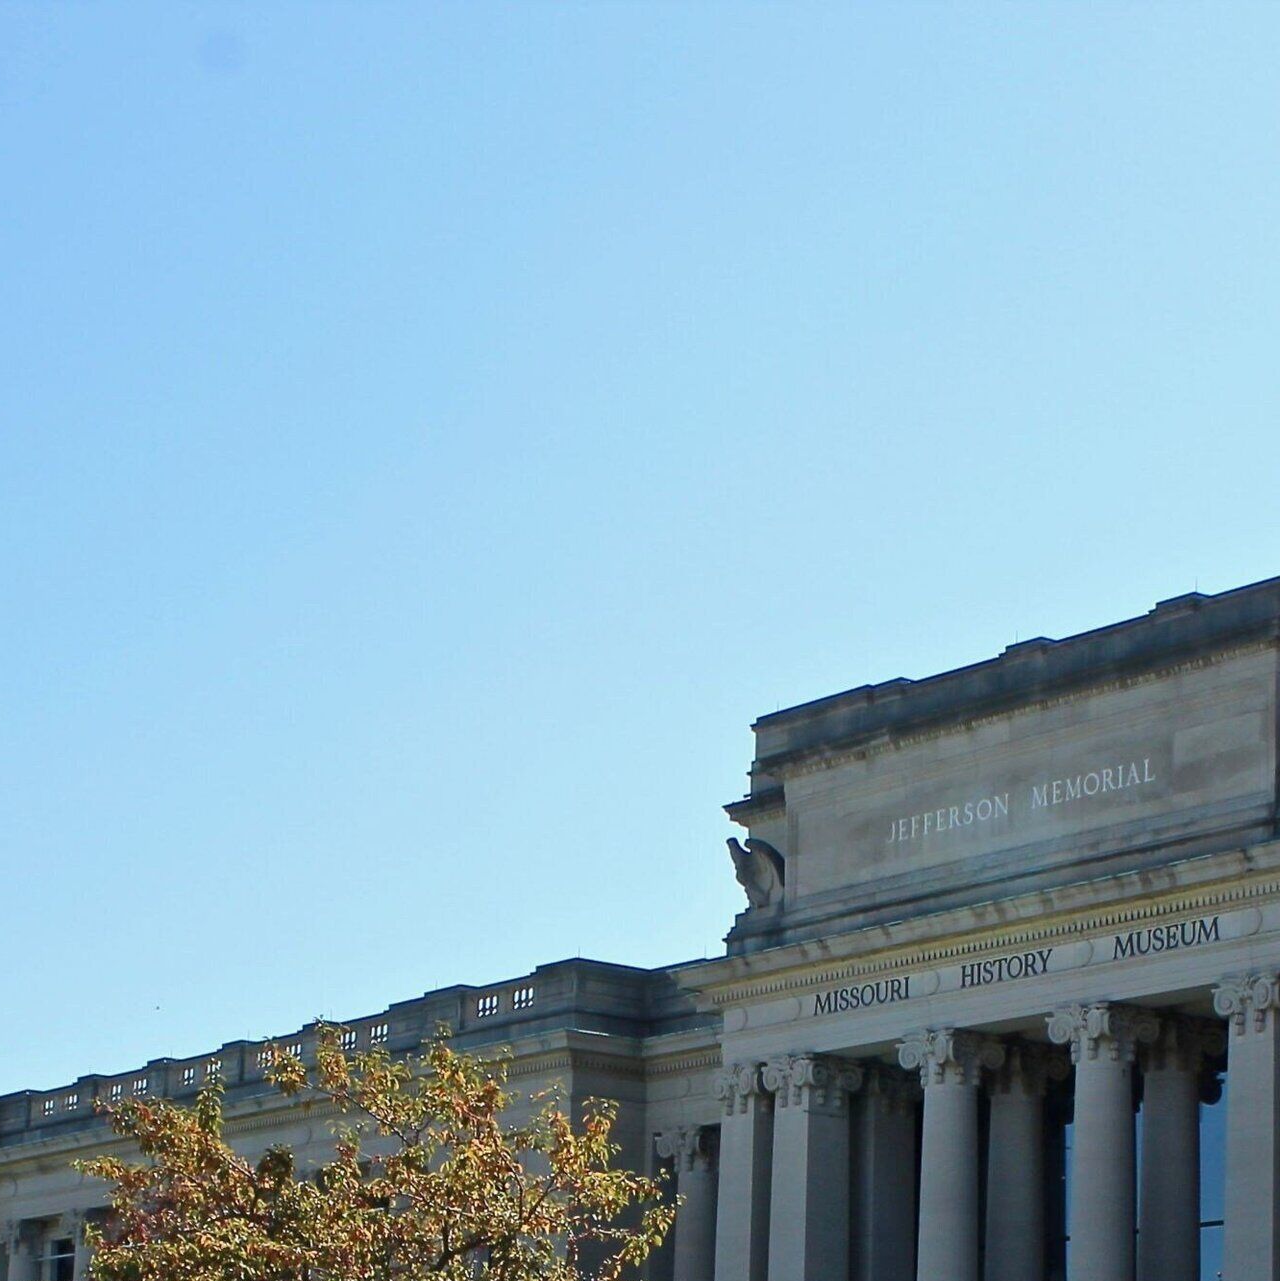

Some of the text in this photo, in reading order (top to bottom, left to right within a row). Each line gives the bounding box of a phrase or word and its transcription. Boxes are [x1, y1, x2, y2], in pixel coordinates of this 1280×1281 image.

[887, 758, 1156, 843] JEFFERSON MEMORIAL
[813, 916, 1220, 1016] MISSOURI HISTORY MUSEUM
